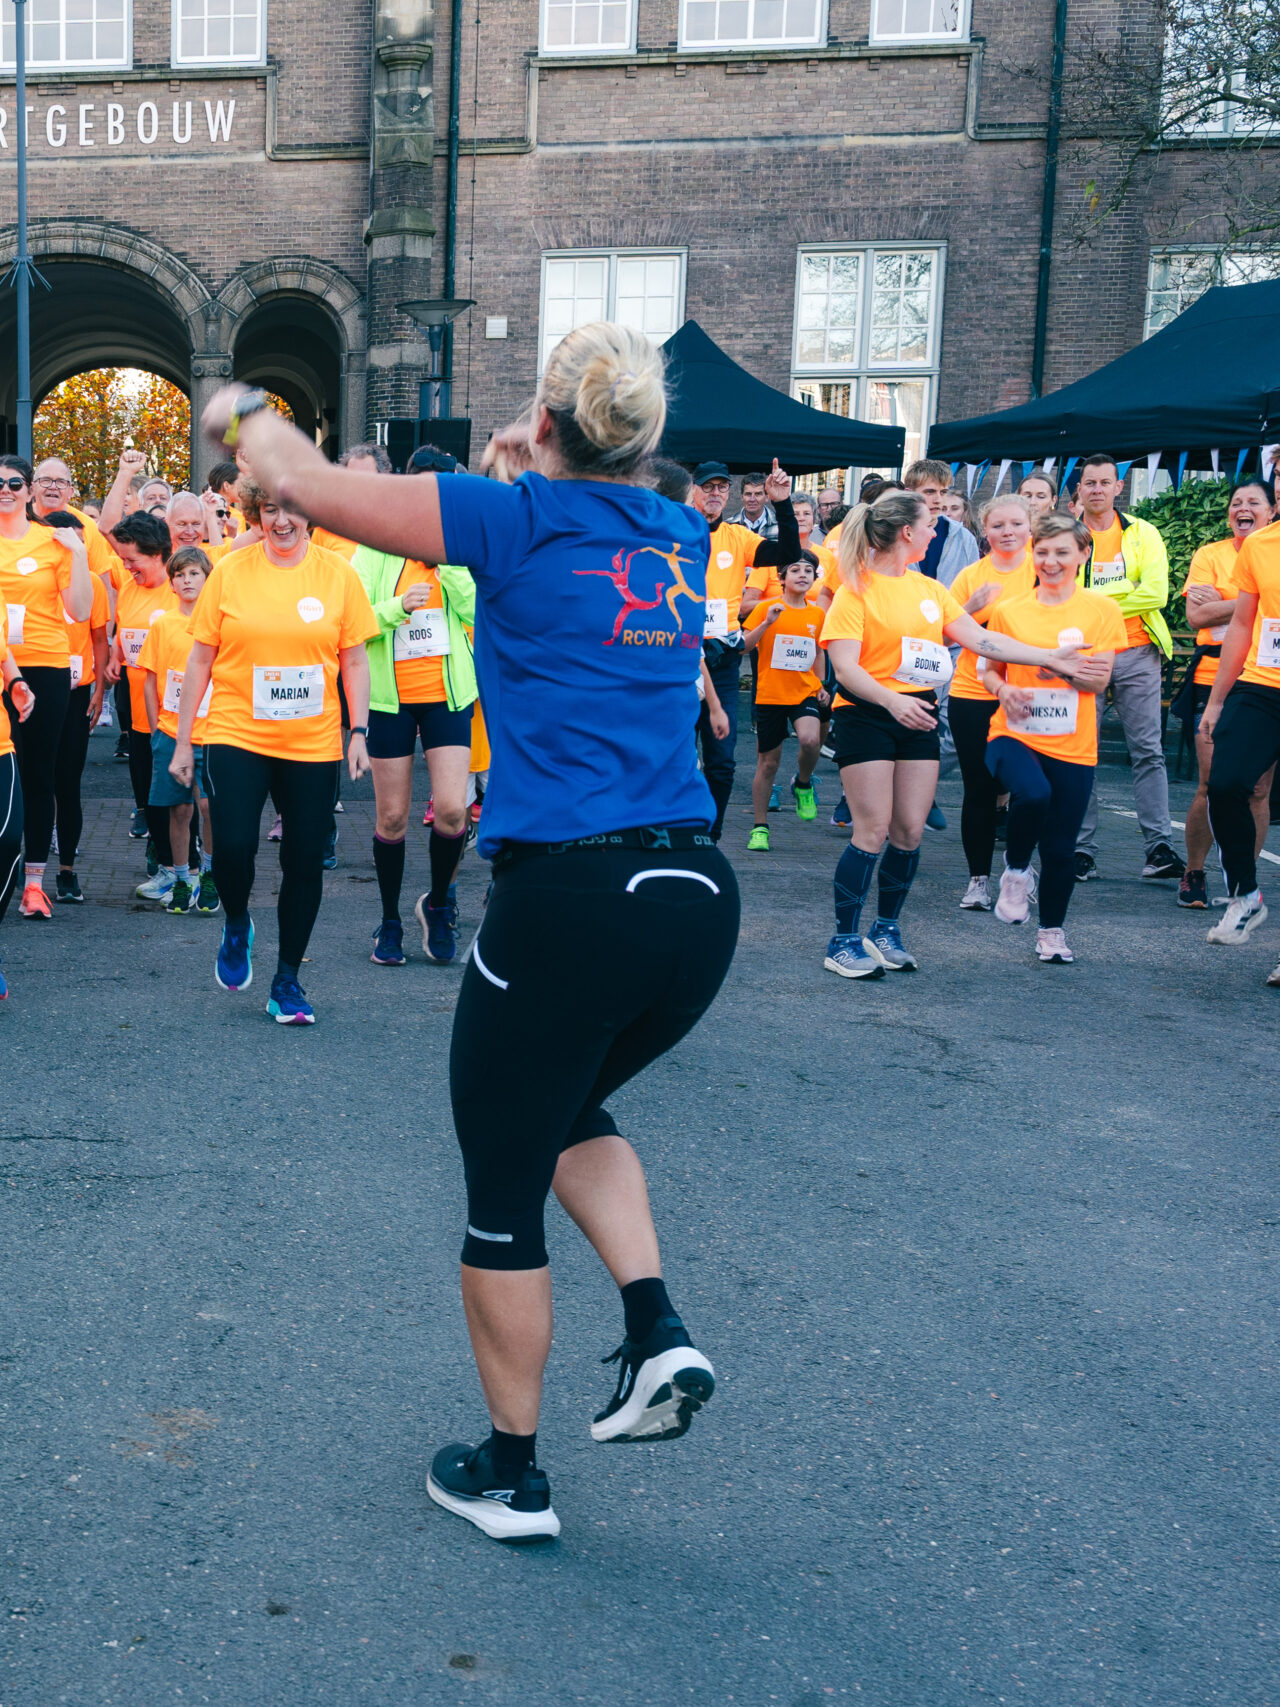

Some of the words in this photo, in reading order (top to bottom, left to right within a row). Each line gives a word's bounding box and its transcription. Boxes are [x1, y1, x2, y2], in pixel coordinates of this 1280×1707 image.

[408, 627, 433, 641] ROOS
[622, 629, 677, 647] RCVRY
[680, 632, 700, 650] RUN
[785, 648, 809, 659] SAMEH
[914, 657, 941, 673] BODINE
[270, 686, 310, 701] MARIAN
